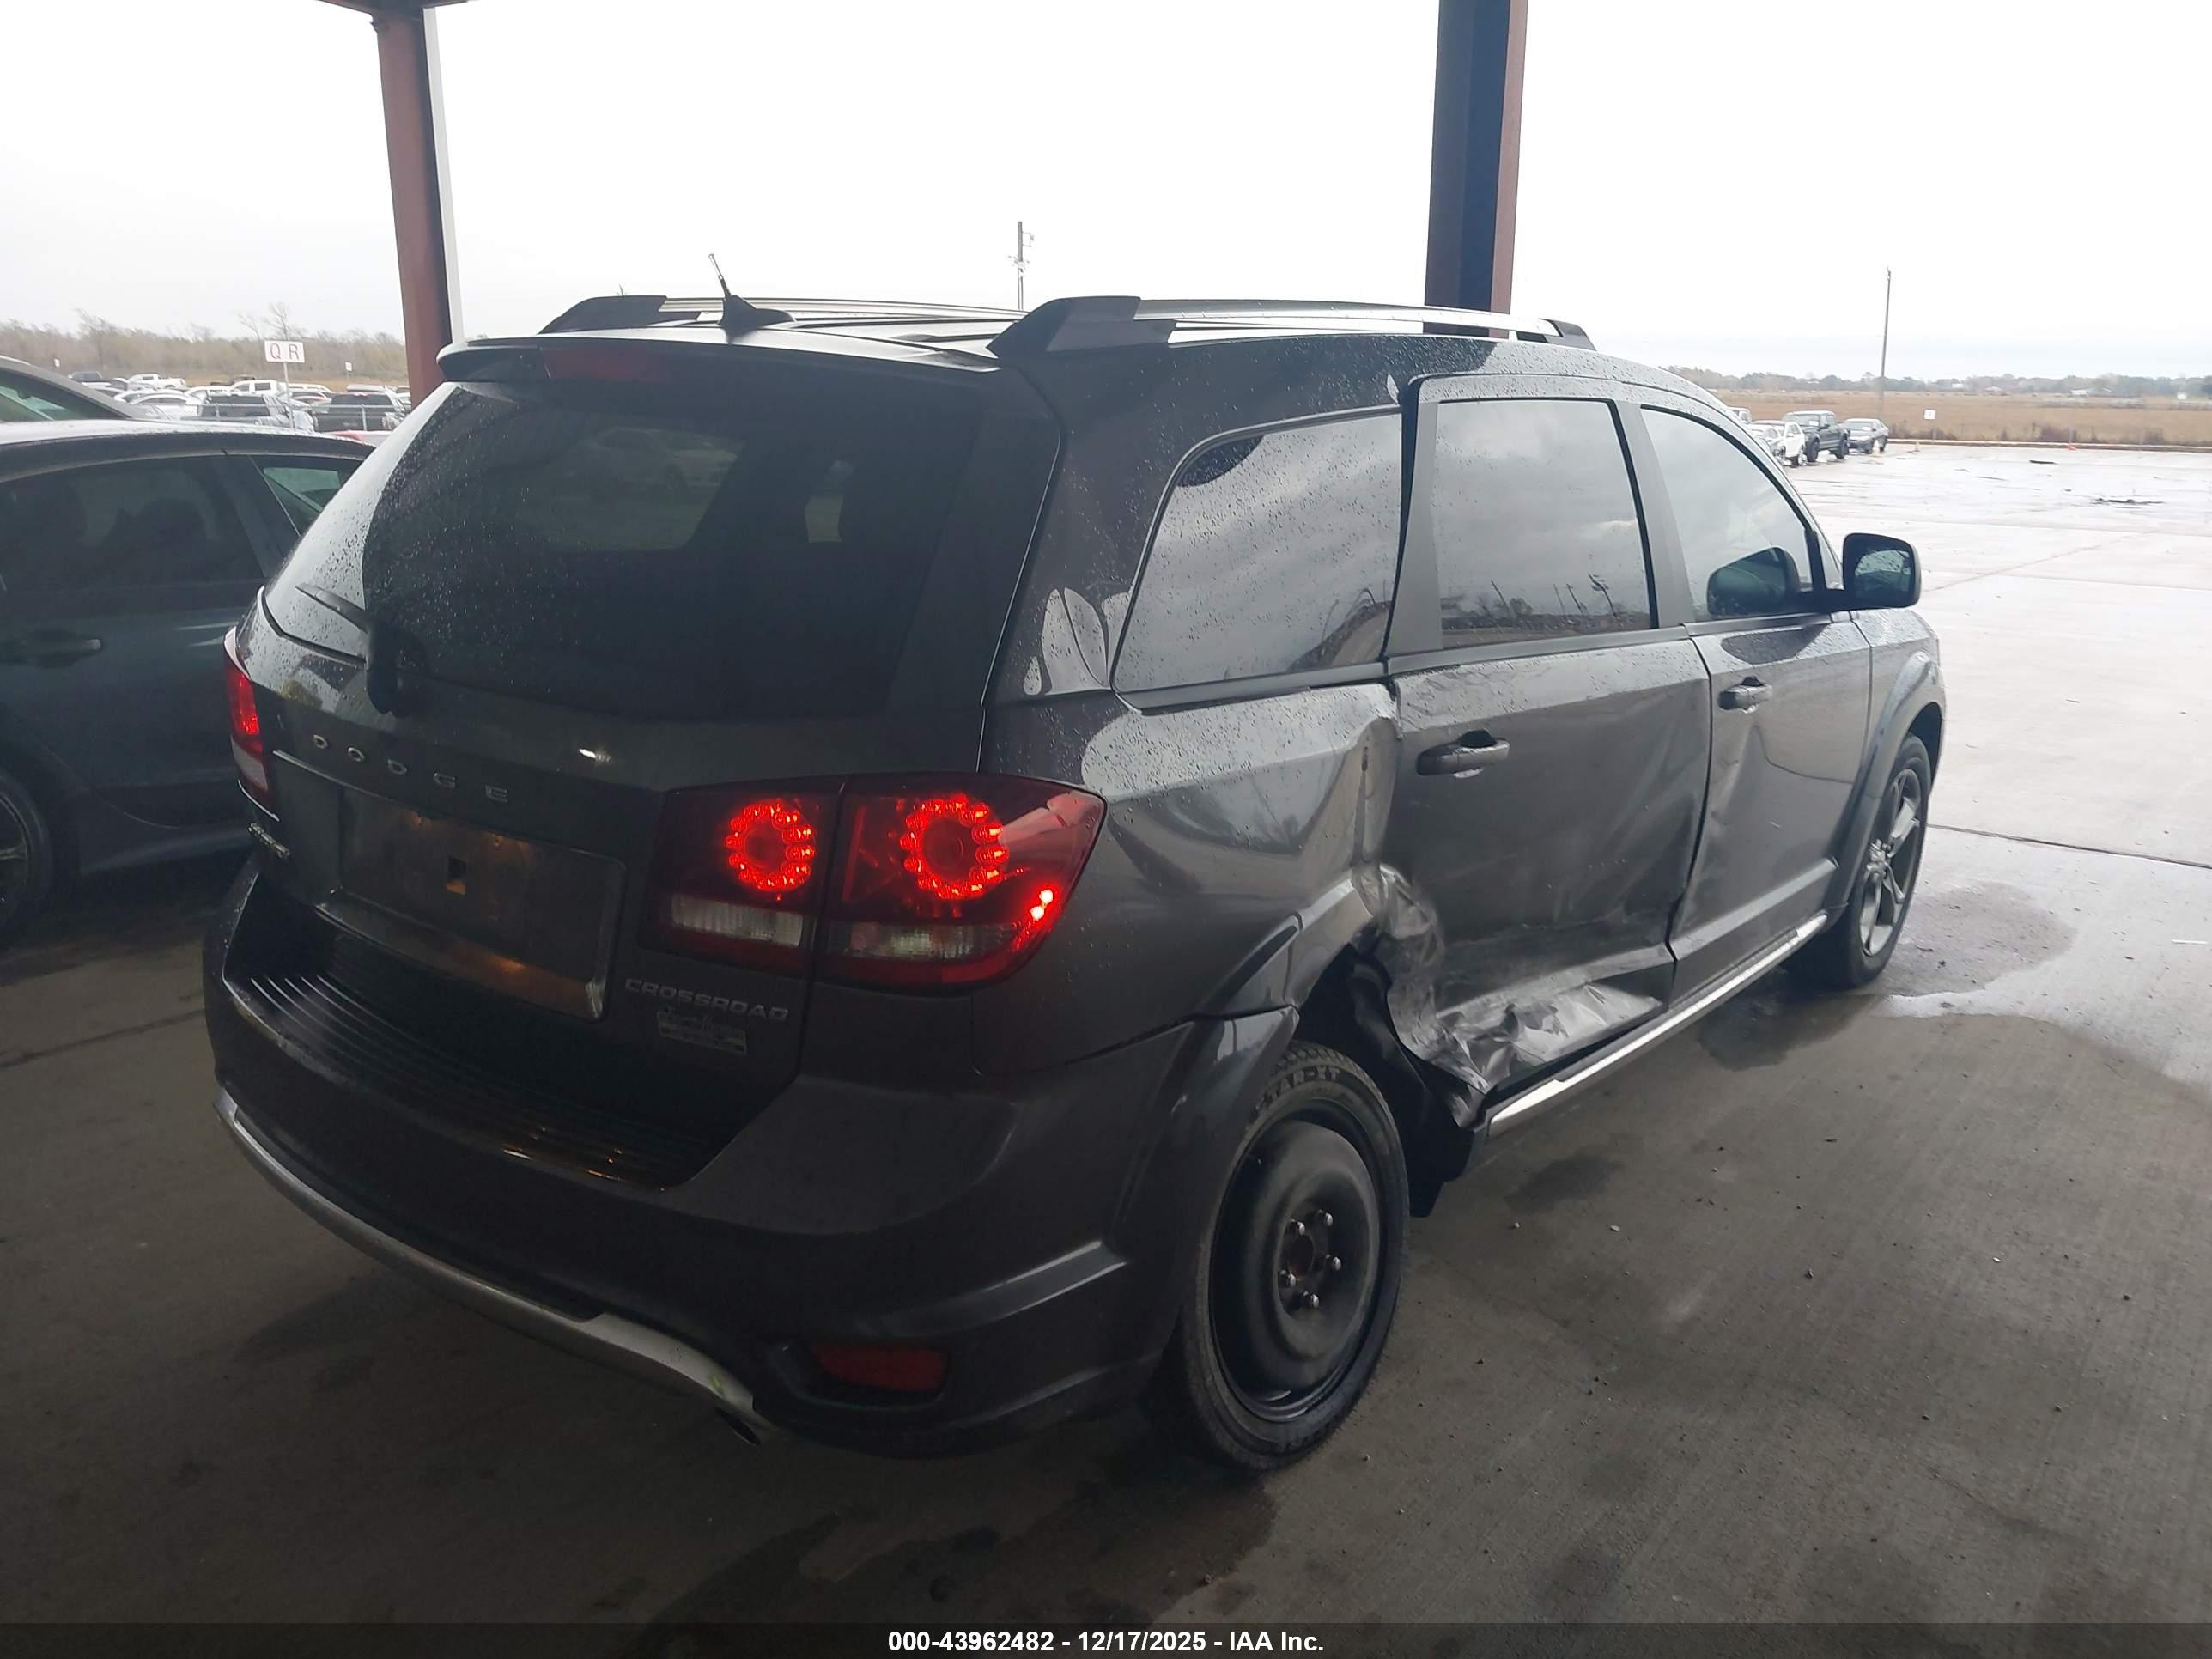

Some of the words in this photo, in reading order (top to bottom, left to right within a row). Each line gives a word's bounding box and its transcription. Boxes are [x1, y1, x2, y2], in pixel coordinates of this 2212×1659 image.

[270, 343, 281, 360] Q
[289, 343, 300, 361] R
[313, 734, 508, 803] DODGE
[624, 978, 789, 1022] CROSSROAD
